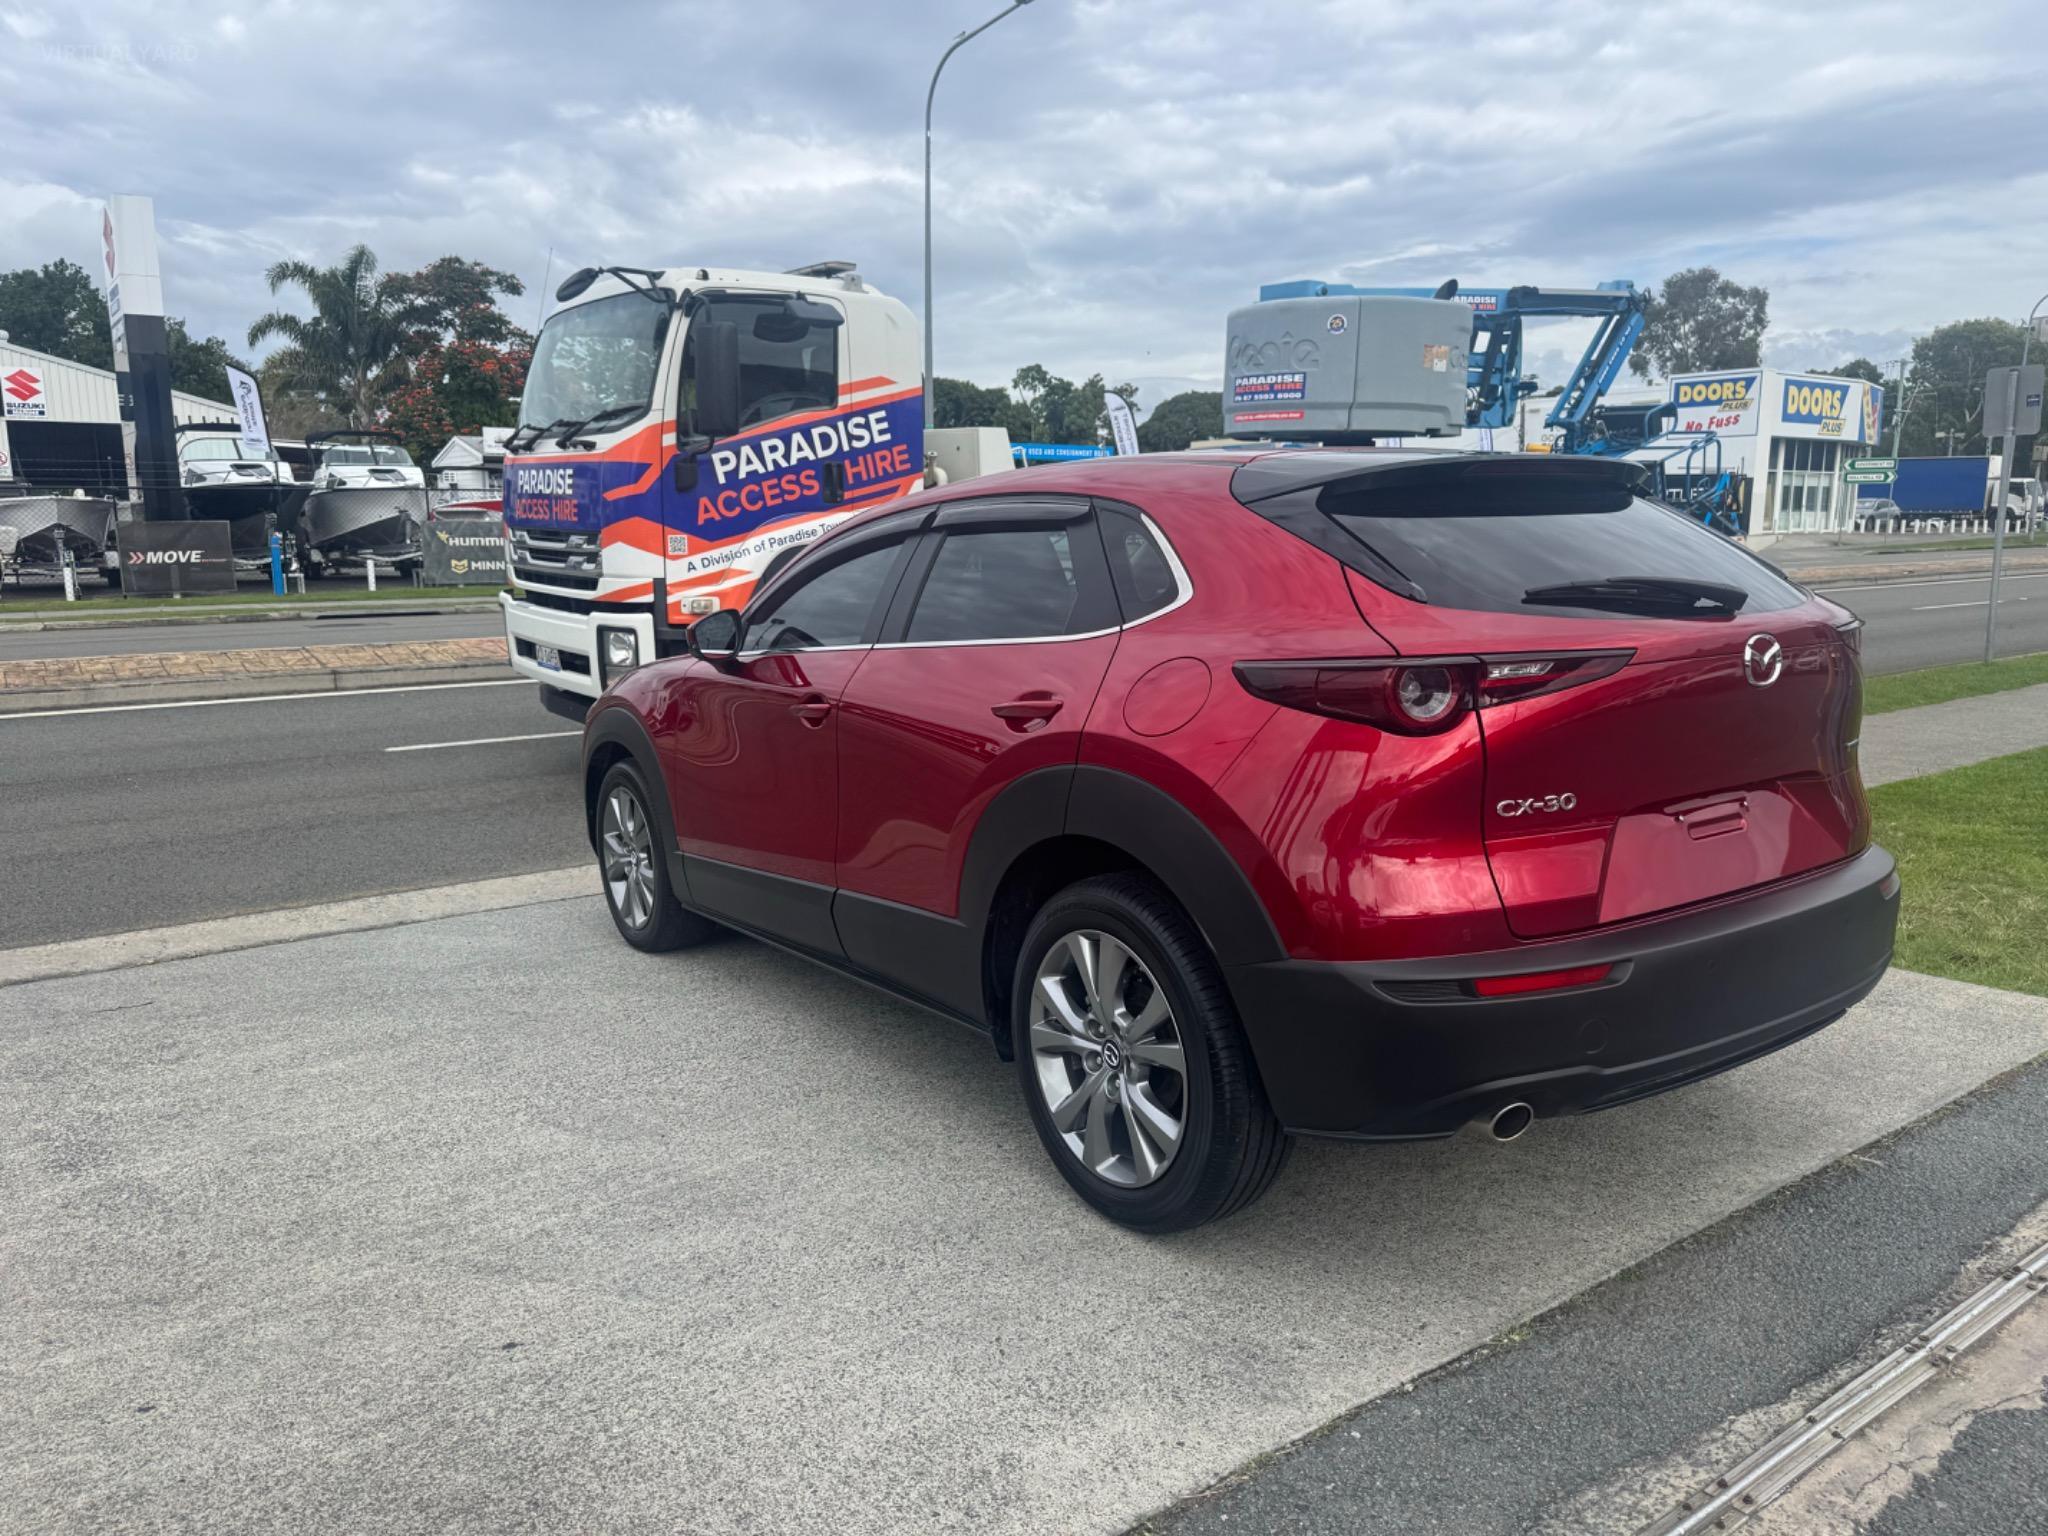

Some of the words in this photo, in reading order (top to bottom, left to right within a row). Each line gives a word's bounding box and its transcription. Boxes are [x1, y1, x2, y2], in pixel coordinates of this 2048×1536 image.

[1236, 374, 1304, 386] PARADISE
[1679, 380, 1746, 403] DOORS
[1787, 385, 1841, 417] DOORS
[1722, 400, 1749, 410] PLUS
[1685, 420, 1703, 431] No
[1708, 415, 1740, 429] Fuss
[1822, 420, 1842, 433] PLUS
[711, 410, 892, 484] PARADISE
[517, 469, 573, 494] PARADISE
[697, 469, 820, 526] ACCESS
[845, 444, 911, 484] HIRE
[515, 499, 549, 520] ACCESS
[552, 500, 578, 521] HIRE
[146, 550, 205, 564] MOVE
[687, 562, 697, 573] A
[701, 544, 750, 569] Division
[753, 535, 767, 552] of
[769, 528, 818, 549] Paradise
[471, 561, 505, 570] MINN
[1496, 792, 1577, 817] CX-30
